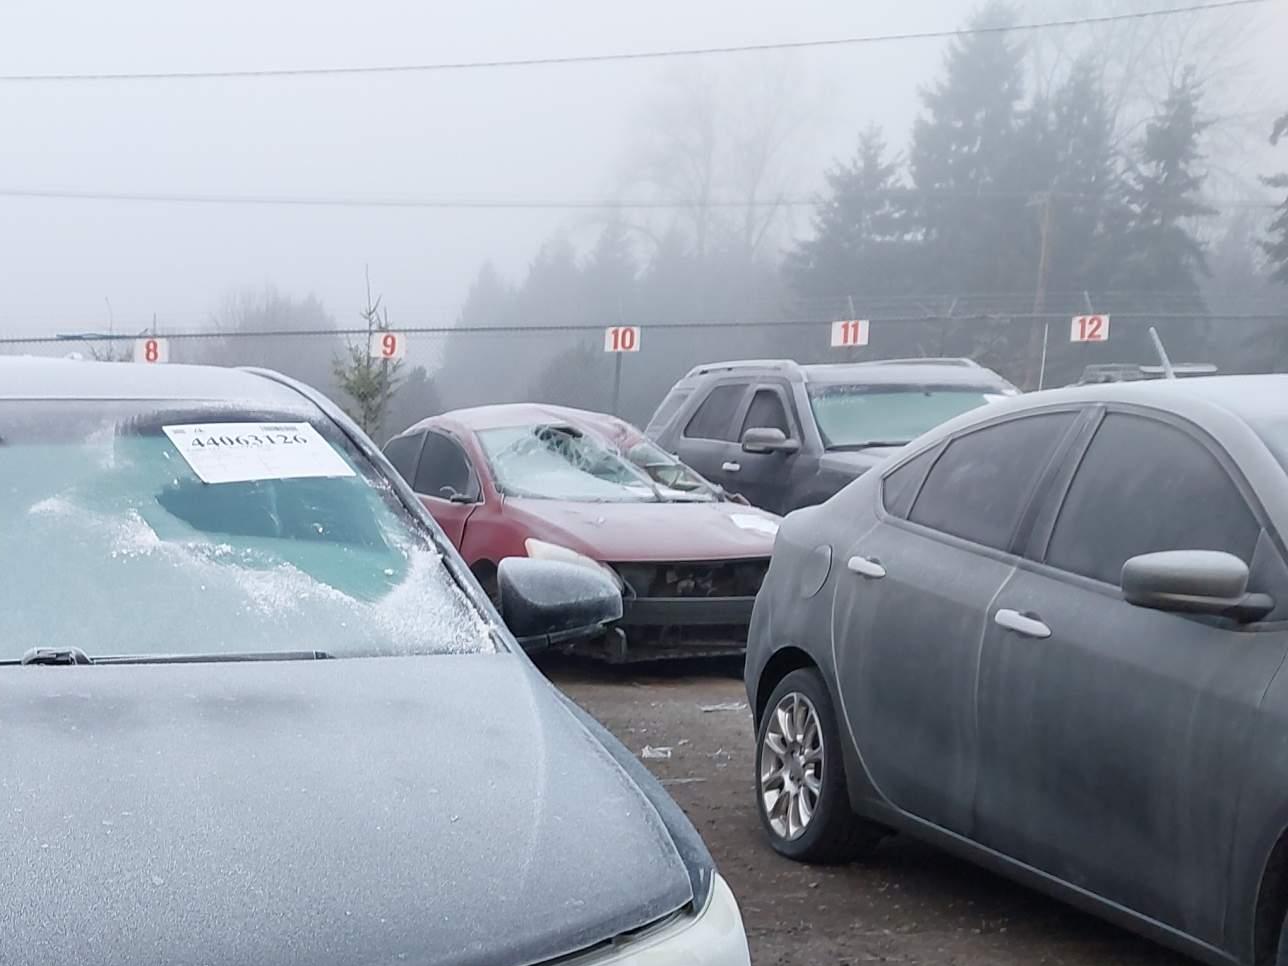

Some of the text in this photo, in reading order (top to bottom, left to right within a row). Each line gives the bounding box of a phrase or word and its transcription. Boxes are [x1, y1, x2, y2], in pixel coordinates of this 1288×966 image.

[611, 327, 635, 350] 10
[841, 320, 860, 344] 11
[1079, 316, 1102, 340] 12
[145, 340, 158, 363] 8
[382, 334, 397, 357] 9
[191, 433, 308, 449] 44063126
